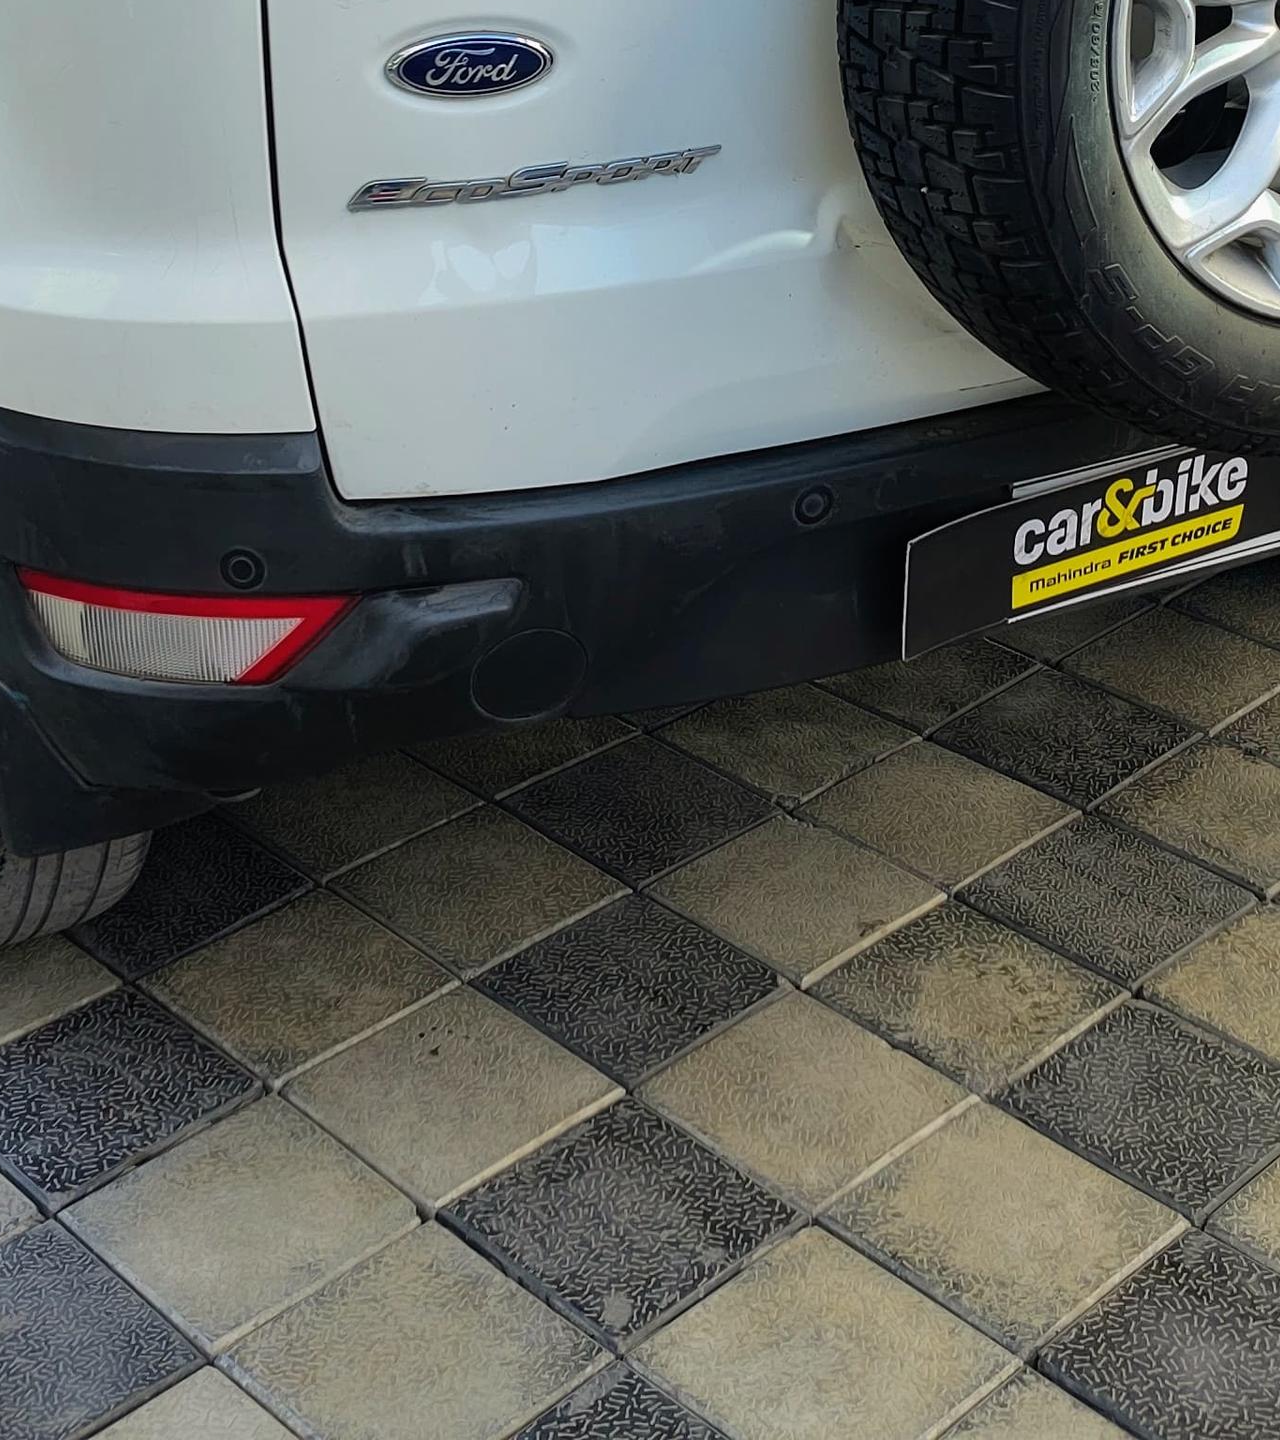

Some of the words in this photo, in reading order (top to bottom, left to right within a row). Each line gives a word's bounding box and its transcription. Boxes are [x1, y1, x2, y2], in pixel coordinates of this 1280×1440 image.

[424, 47, 519, 86] Ford
[1013, 454, 1249, 566] car&bike
[1029, 558, 1112, 593] Mahindra
[1118, 537, 1170, 565] FIRST
[1169, 517, 1234, 548] CHOICE
